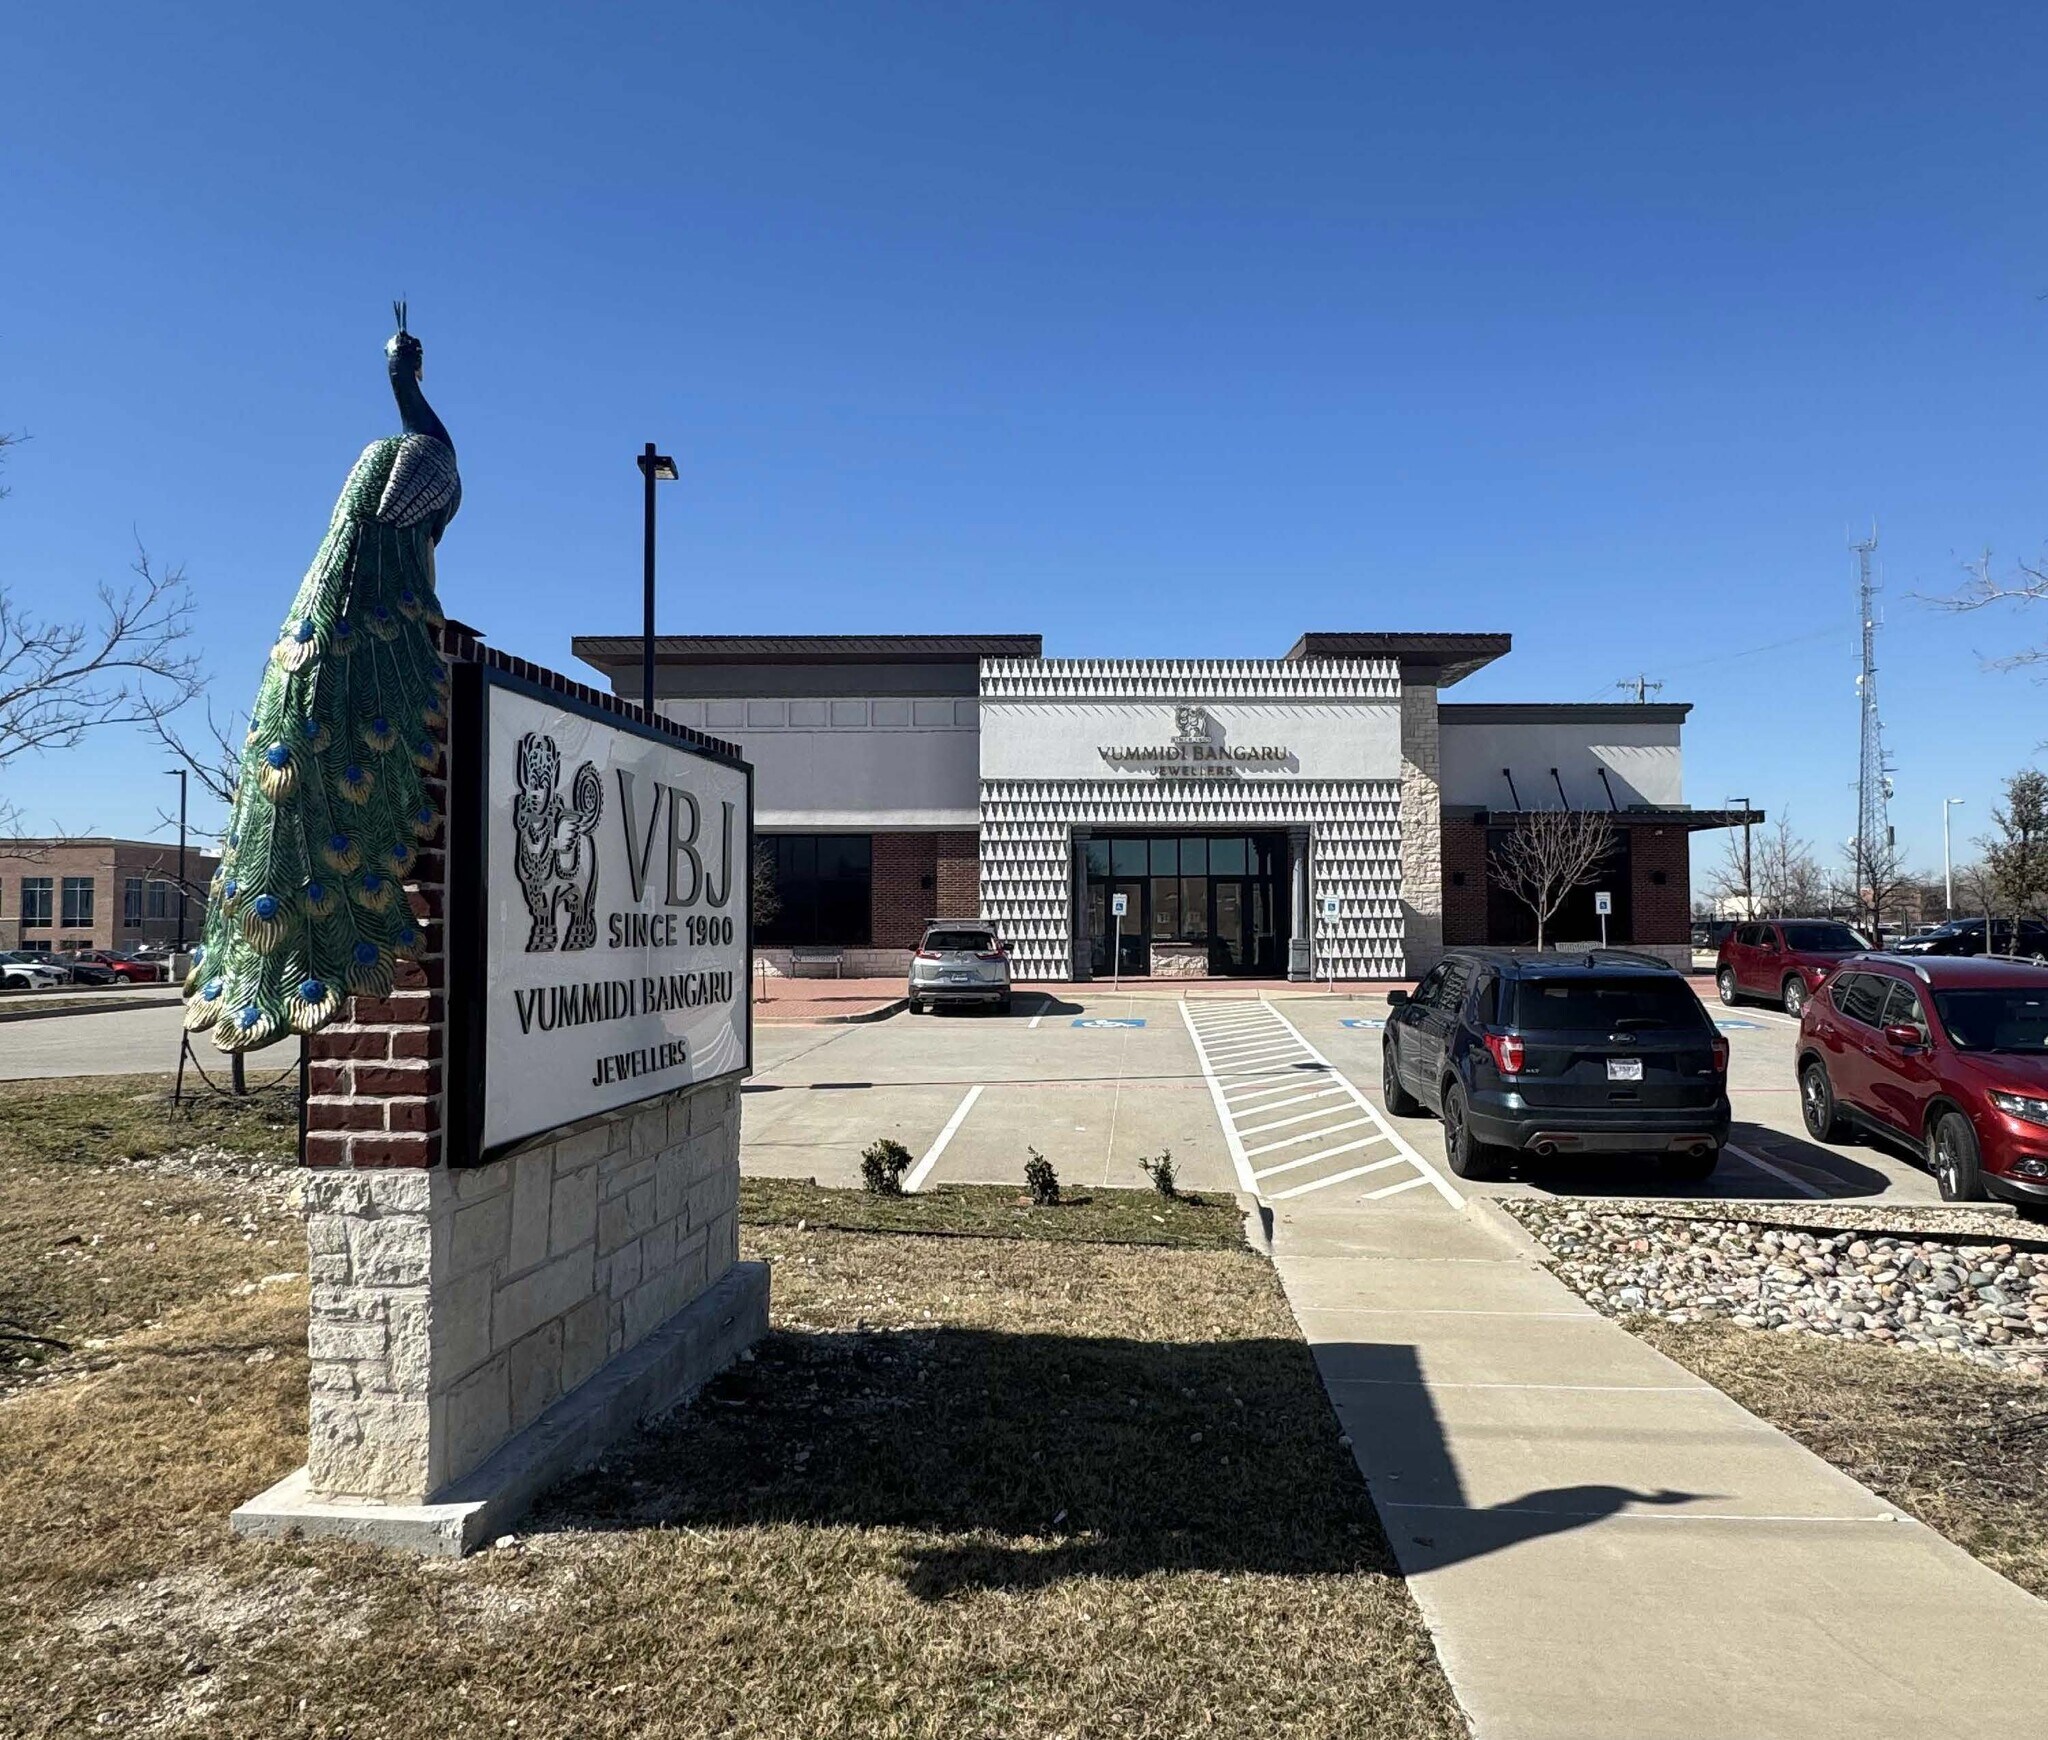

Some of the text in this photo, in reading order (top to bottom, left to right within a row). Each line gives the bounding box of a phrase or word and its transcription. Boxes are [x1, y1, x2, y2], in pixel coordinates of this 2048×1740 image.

[1097, 746, 1287, 761] VUMMIDI BANGARU
[1150, 766, 1233, 776] JEWELLERS
[617, 768, 735, 908] VBJ
[609, 913, 735, 948] SINCE 1900
[514, 971, 733, 1034] VUMMIDI BANGARU
[592, 1040, 686, 1087] JEWELLERS
